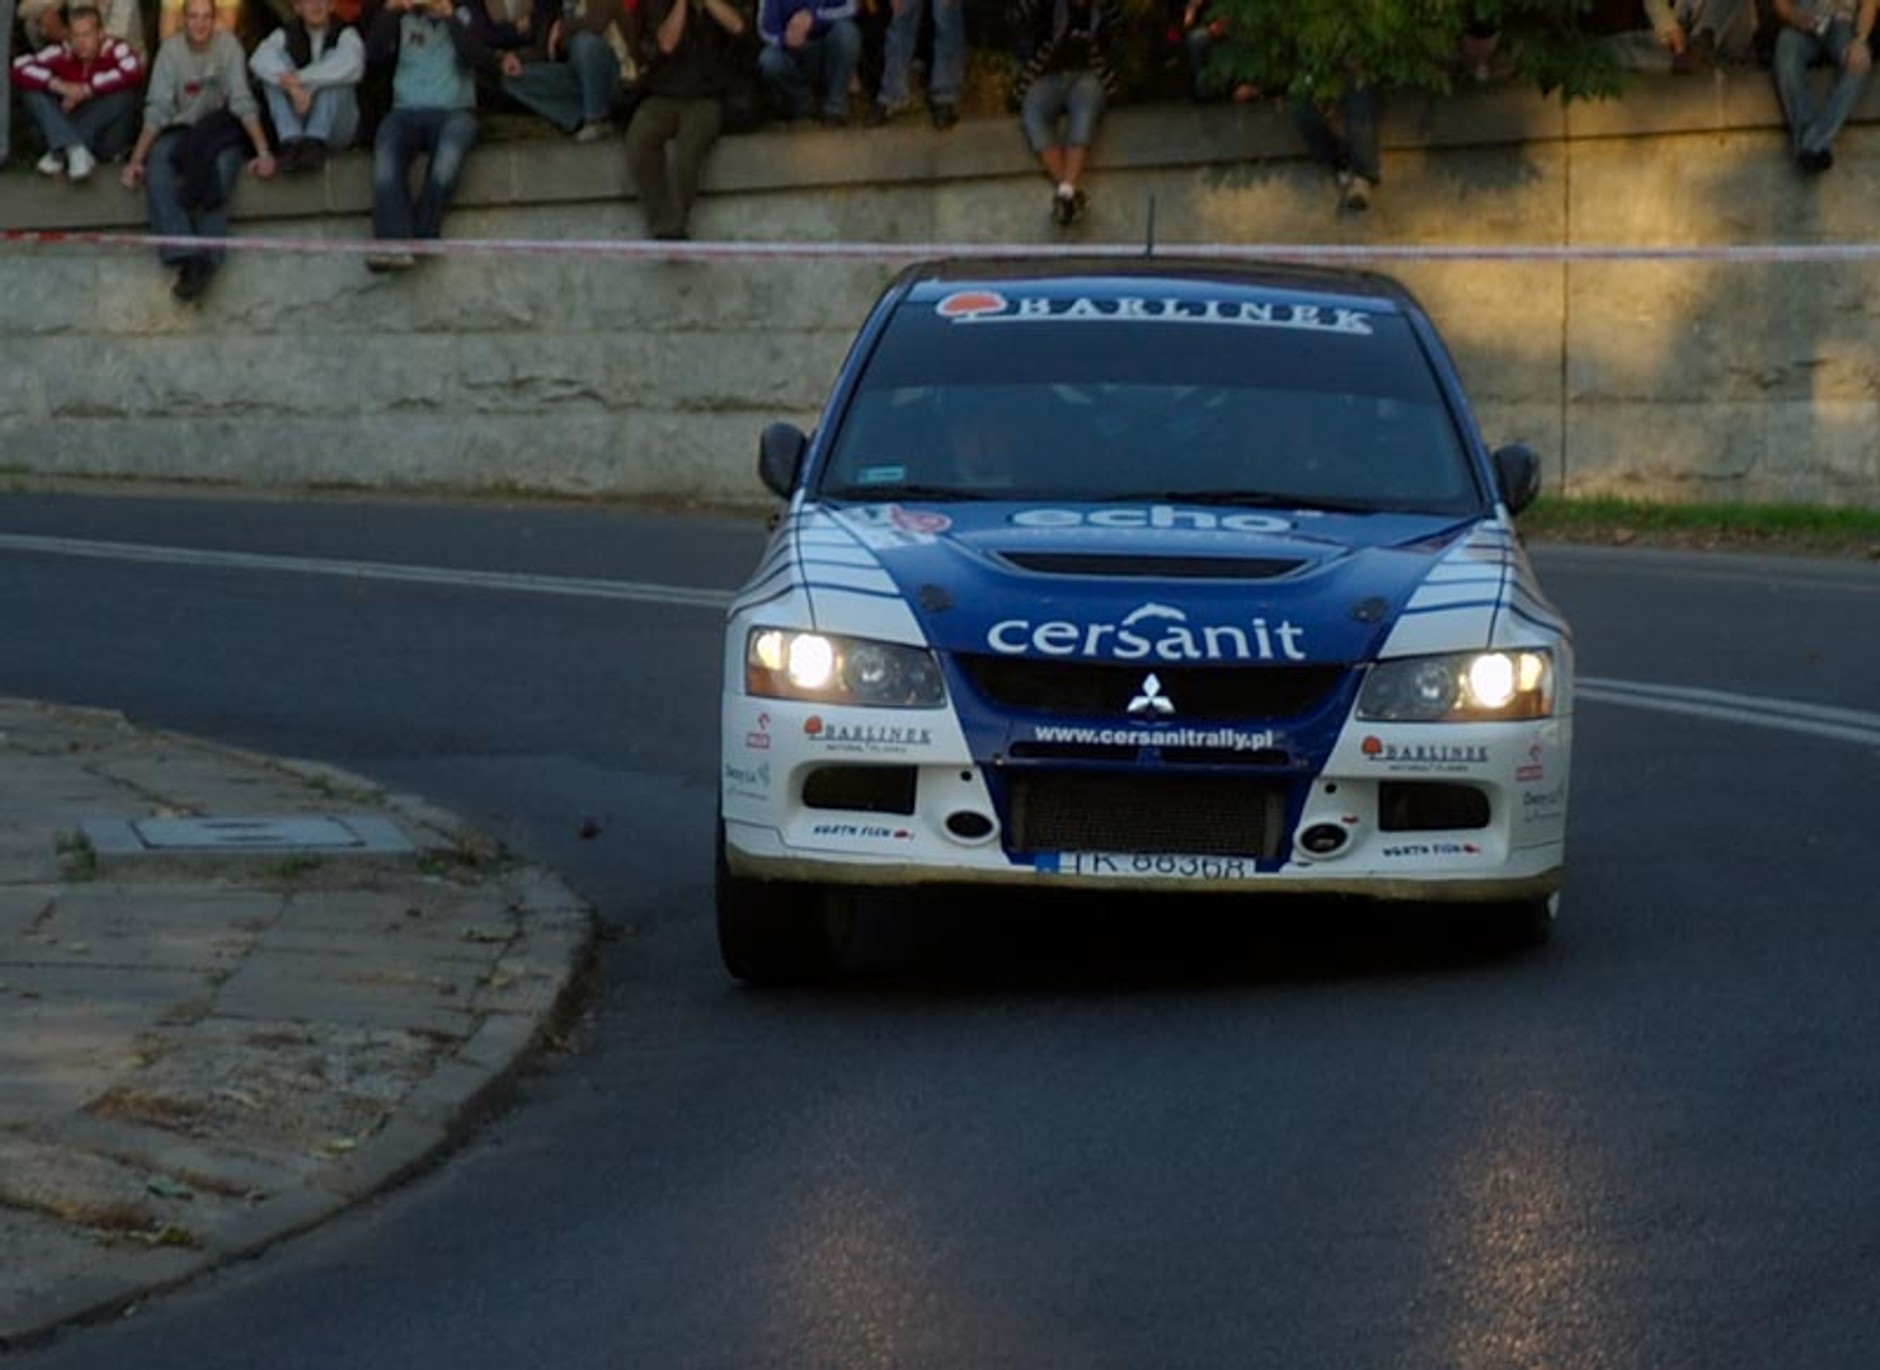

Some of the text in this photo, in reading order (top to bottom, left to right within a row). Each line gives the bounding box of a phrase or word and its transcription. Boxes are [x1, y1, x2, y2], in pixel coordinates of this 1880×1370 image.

[1018, 297, 1372, 331] BARLINEK
[987, 616, 1305, 661] cersanit
[825, 724, 931, 744] BARLINEK
[1034, 726, 1273, 750] www.cersanitrally.pl
